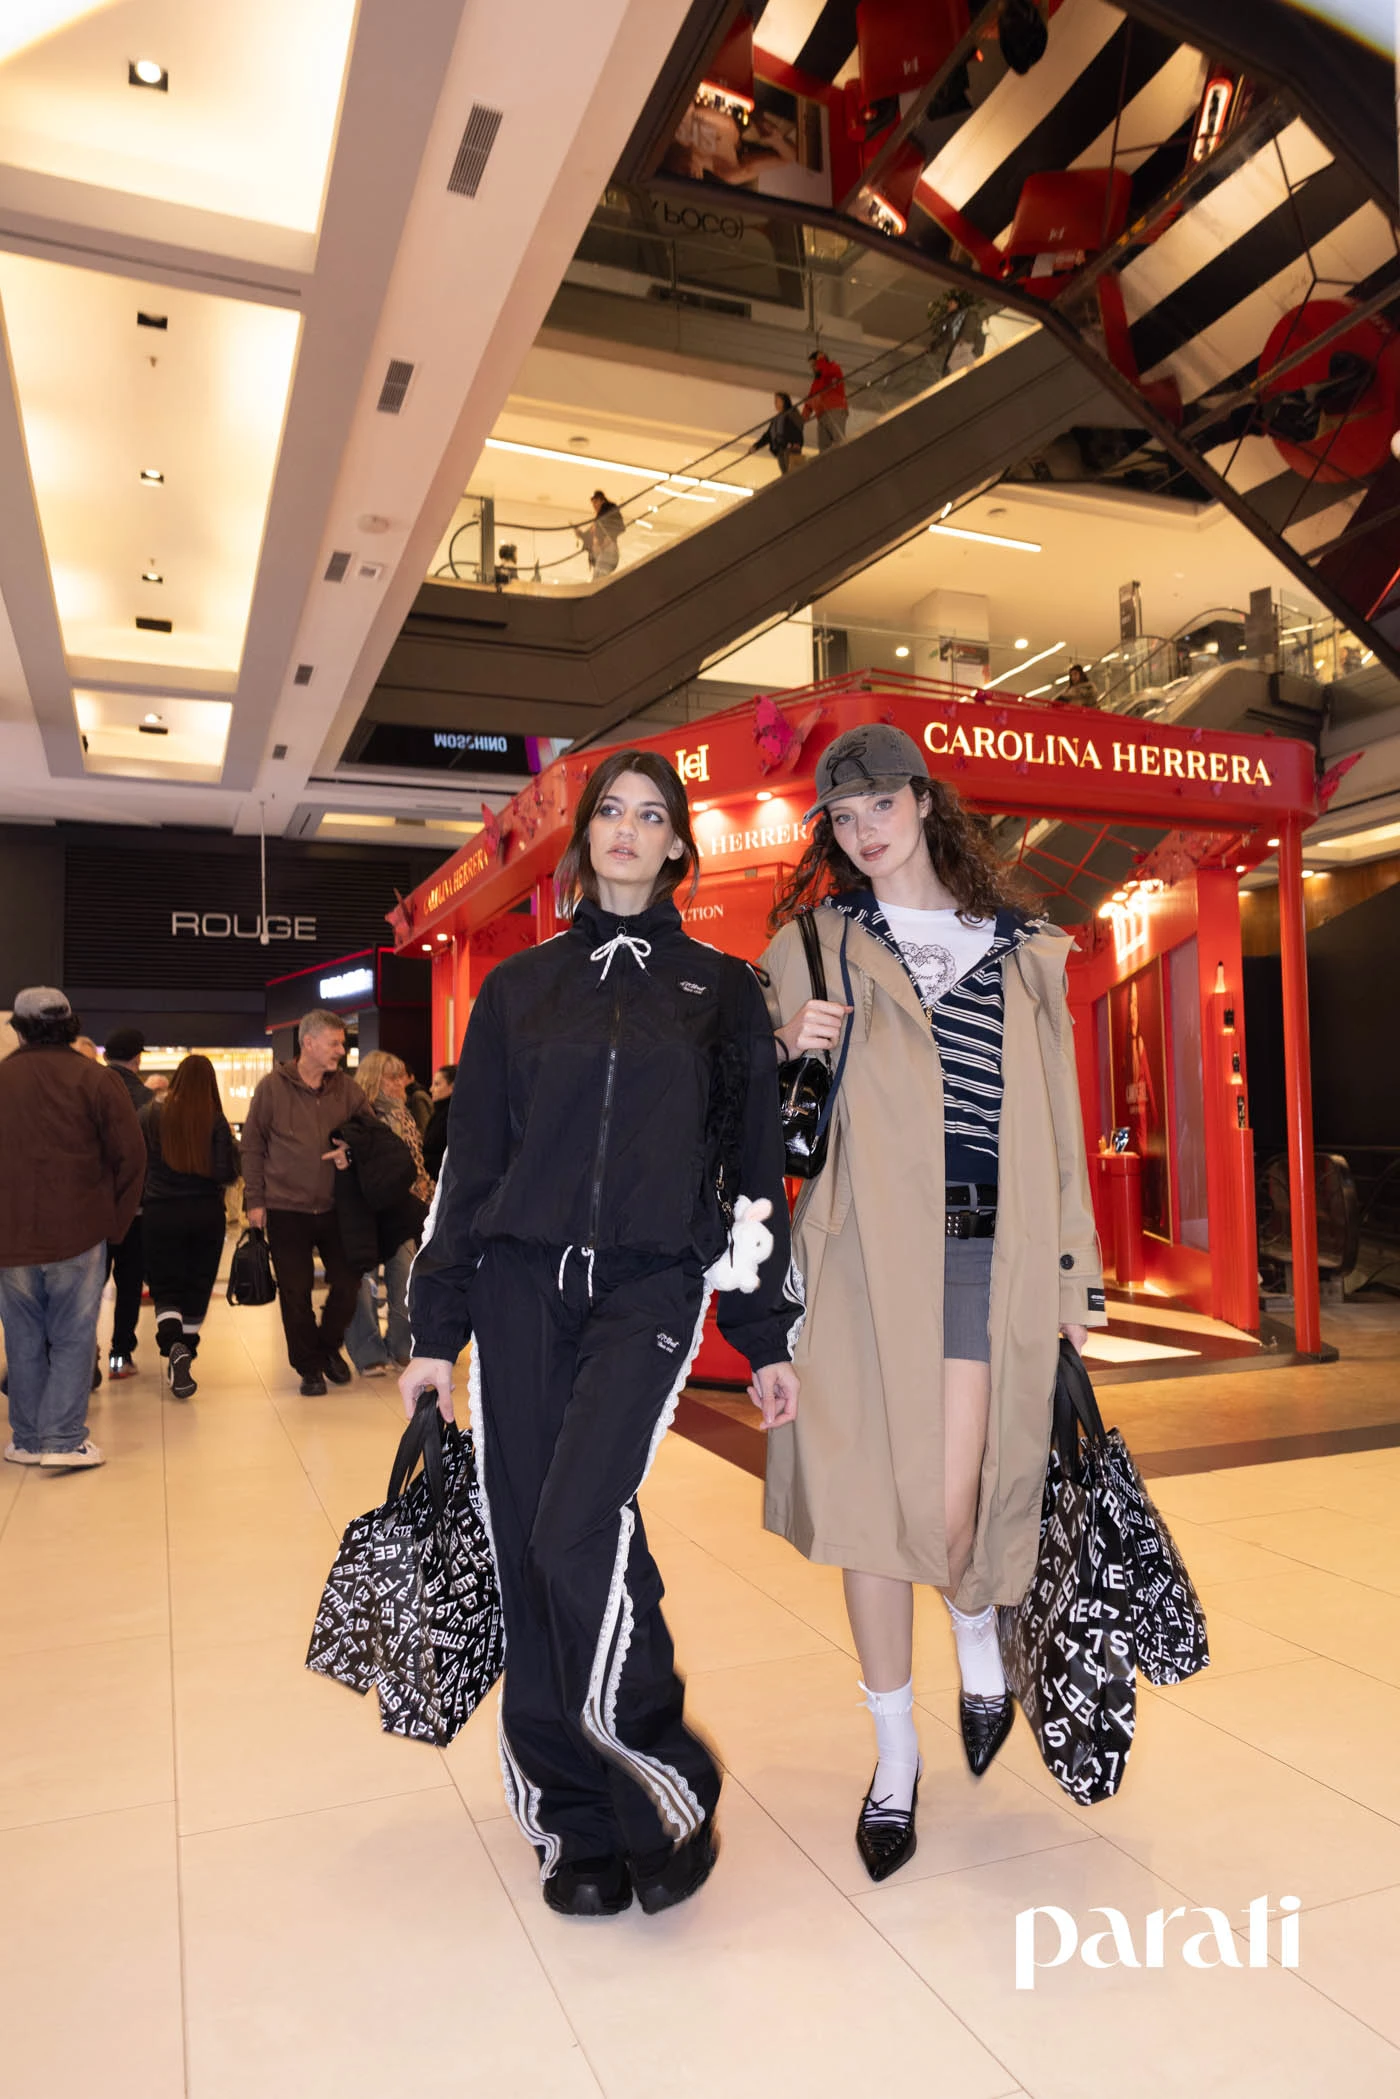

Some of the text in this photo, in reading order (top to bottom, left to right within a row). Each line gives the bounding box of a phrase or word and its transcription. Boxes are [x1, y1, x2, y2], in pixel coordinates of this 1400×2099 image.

[923, 721, 1272, 787] CAROLINA HERRERA
[711, 820, 817, 856] HERRER
[172, 911, 317, 940] ROUGE
[679, 904, 724, 923] CTION
